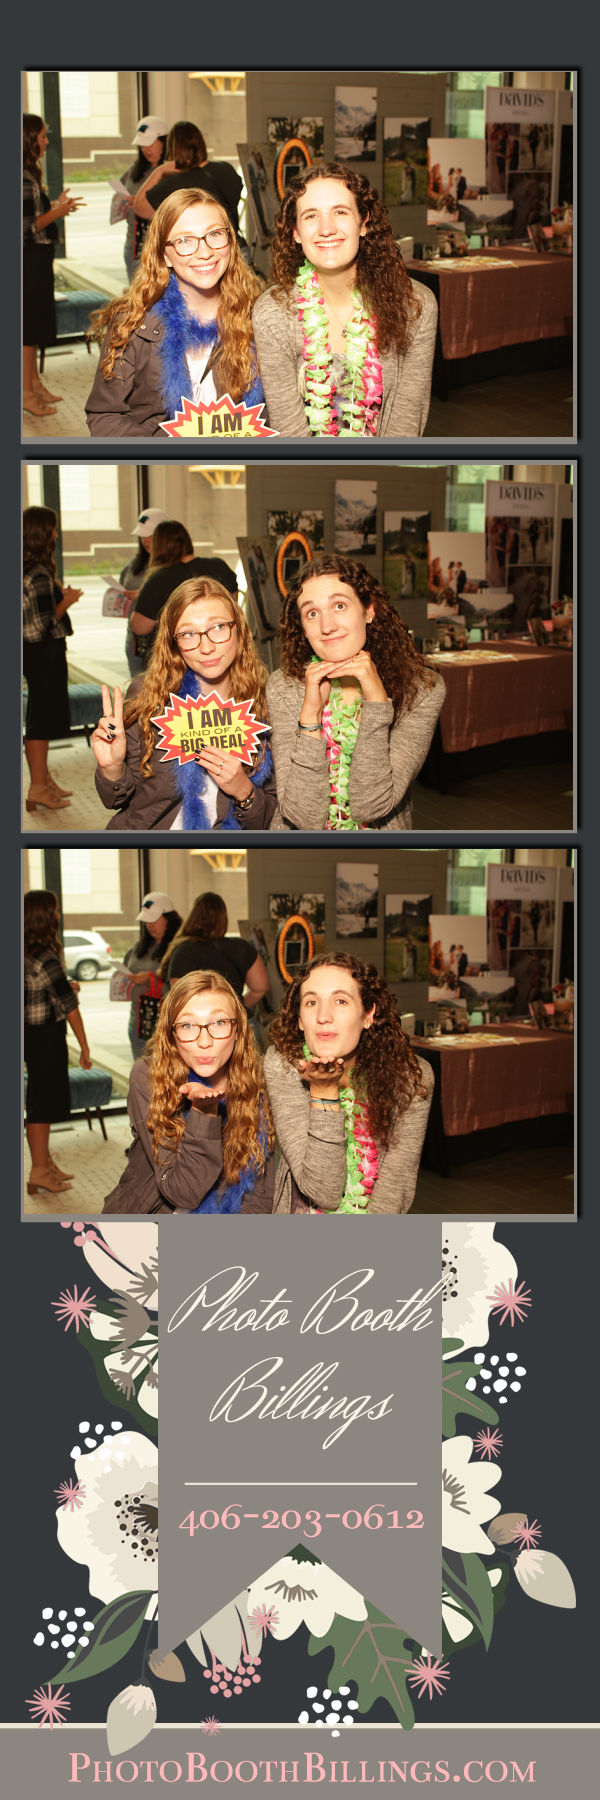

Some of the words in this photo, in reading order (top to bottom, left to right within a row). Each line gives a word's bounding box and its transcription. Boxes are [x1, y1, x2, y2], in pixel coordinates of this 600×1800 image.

[198, 416, 204, 435] I
[211, 412, 242, 434] AM
[187, 711, 194, 730] I
[201, 707, 233, 728] AM
[181, 729, 211, 738] KIND
[214, 727, 231, 735] OF
[180, 738, 205, 753] BIG
[209, 734, 246, 749] DEAL
